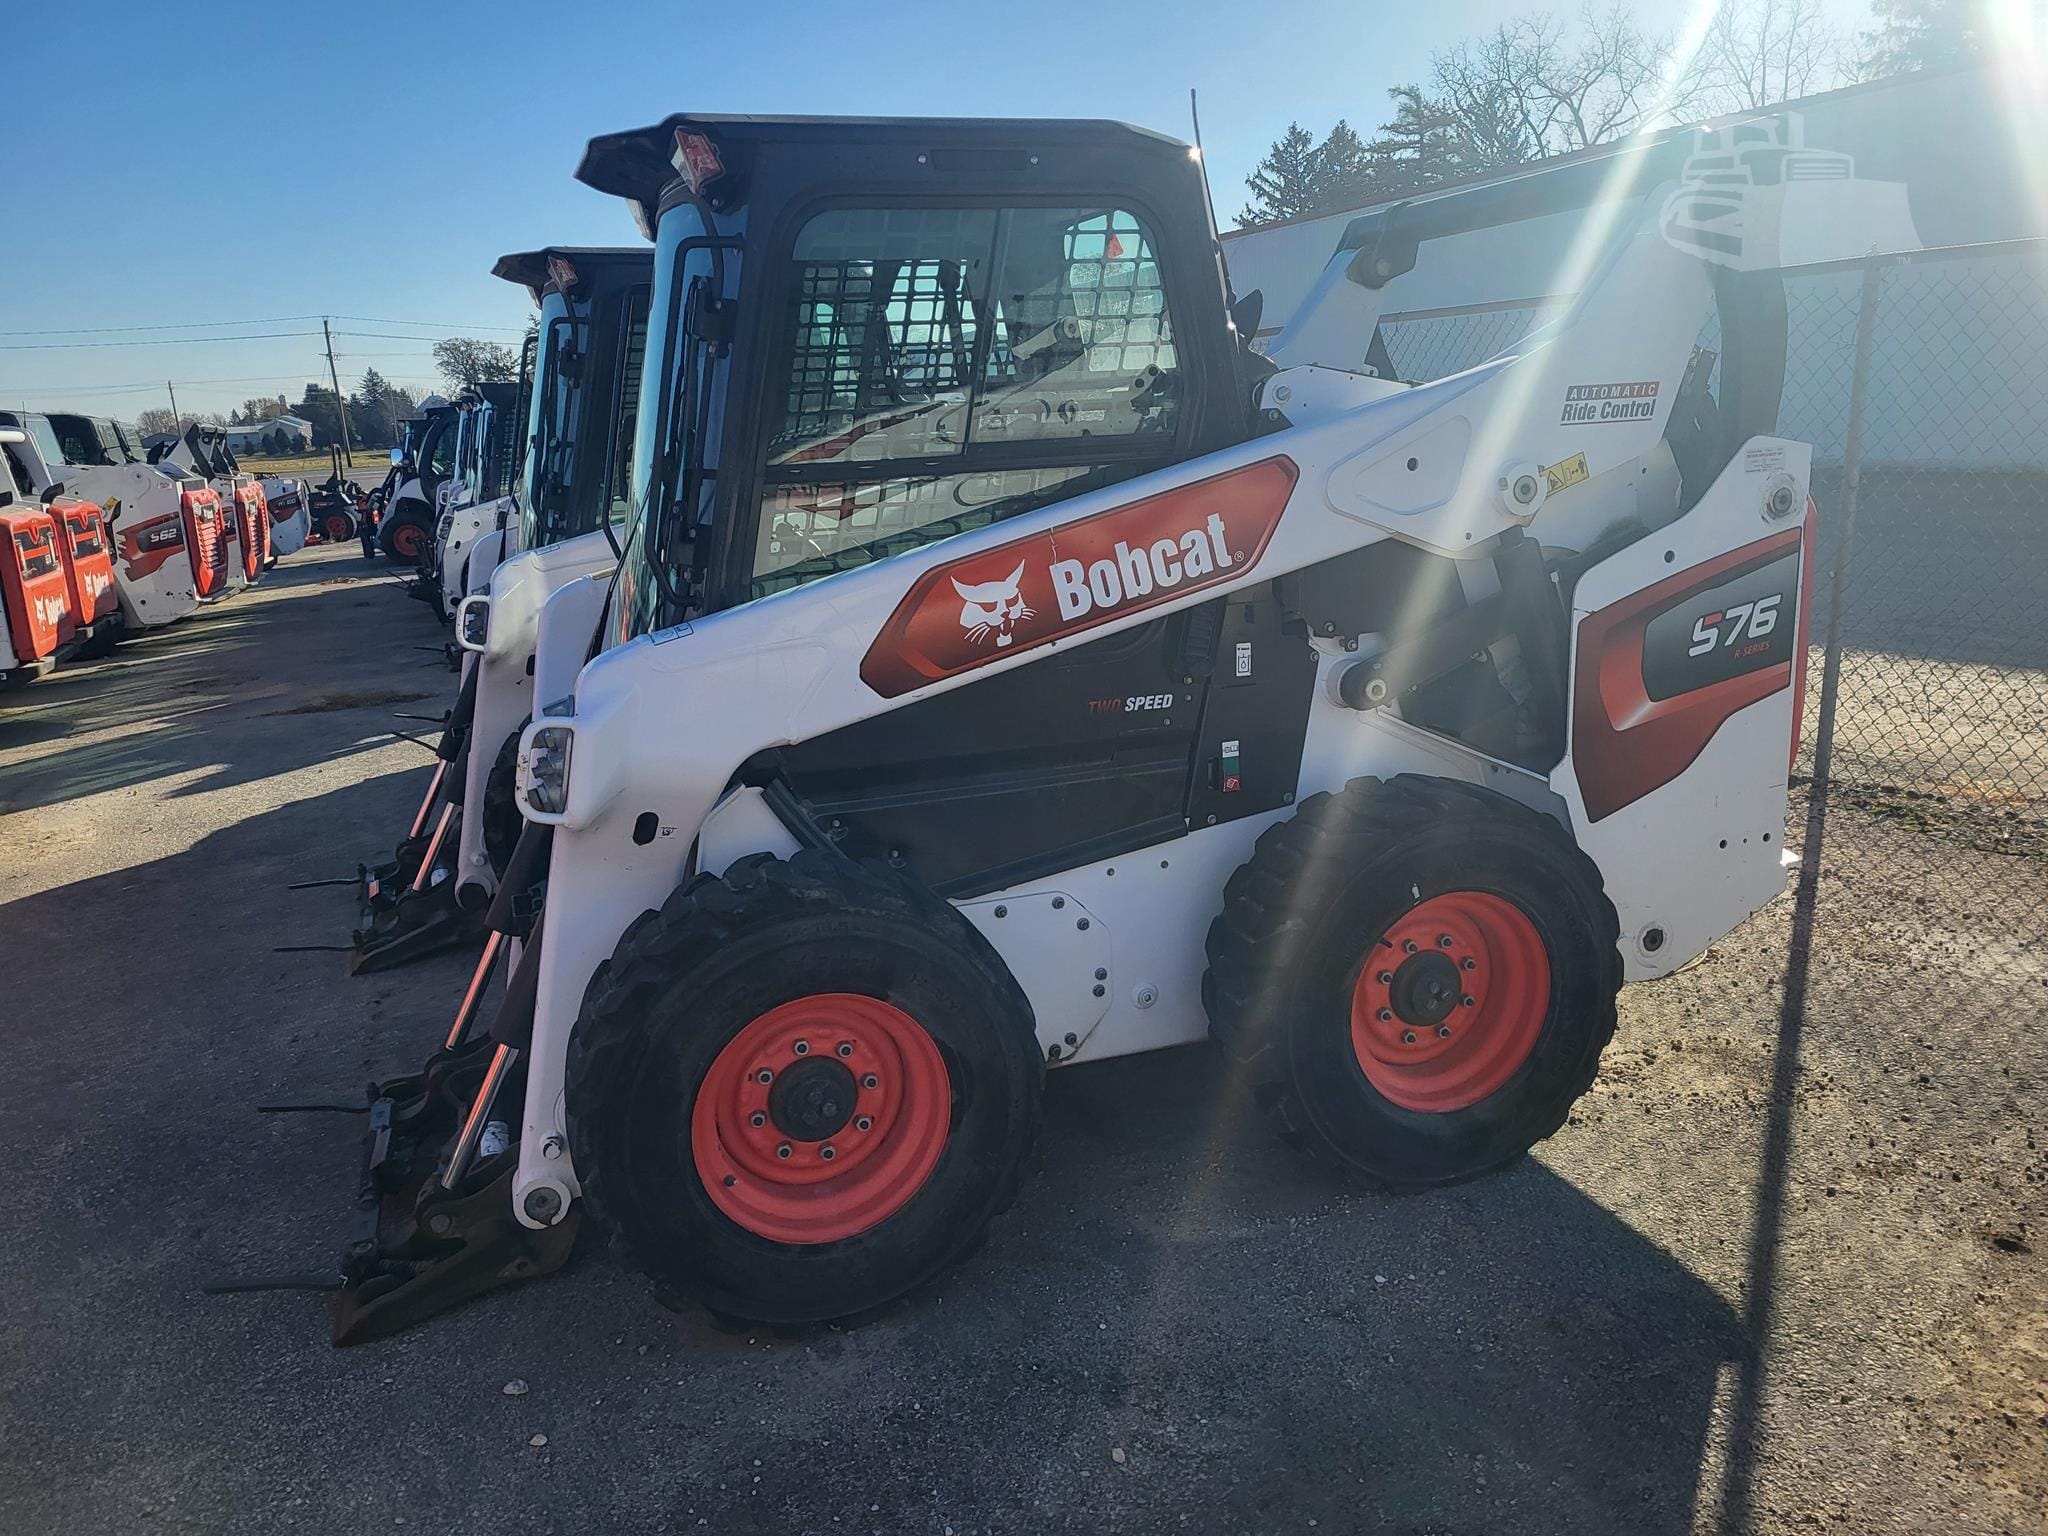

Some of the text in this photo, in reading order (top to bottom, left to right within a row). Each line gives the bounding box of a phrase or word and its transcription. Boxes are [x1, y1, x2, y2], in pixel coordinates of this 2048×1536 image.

[1569, 384, 1656, 400] AUTOMATIC
[1561, 398, 1657, 422] Ride Control
[150, 528, 177, 543] S62
[1688, 594, 1782, 657] S76
[1734, 641, 1770, 659] R-SERIES
[1088, 693, 1174, 713] TWO SPEED
